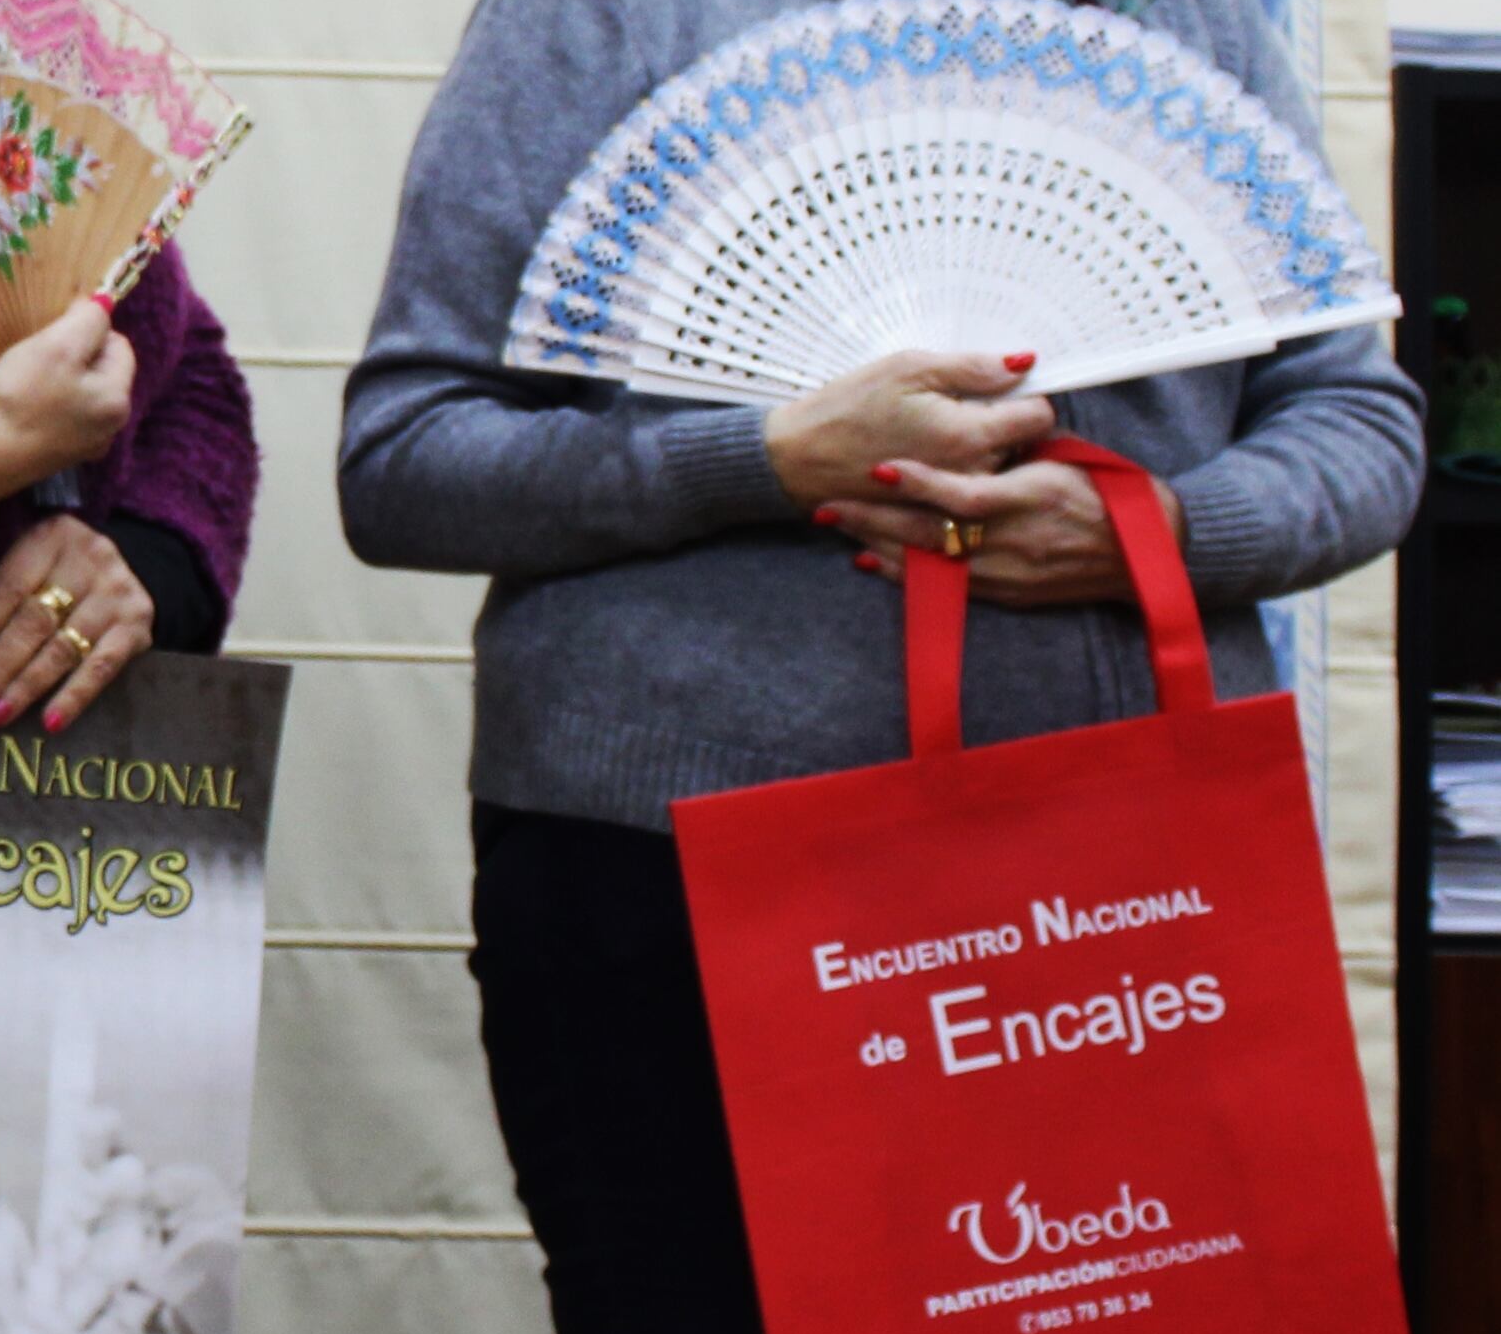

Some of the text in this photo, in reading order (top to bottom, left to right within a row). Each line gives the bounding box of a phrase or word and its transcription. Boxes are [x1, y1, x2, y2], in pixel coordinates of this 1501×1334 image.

[811, 886, 1213, 992] ENCUENTRO NACIONAL
[860, 972, 1227, 1077] de Encajes
[947, 1181, 1172, 1265] Úbeda
